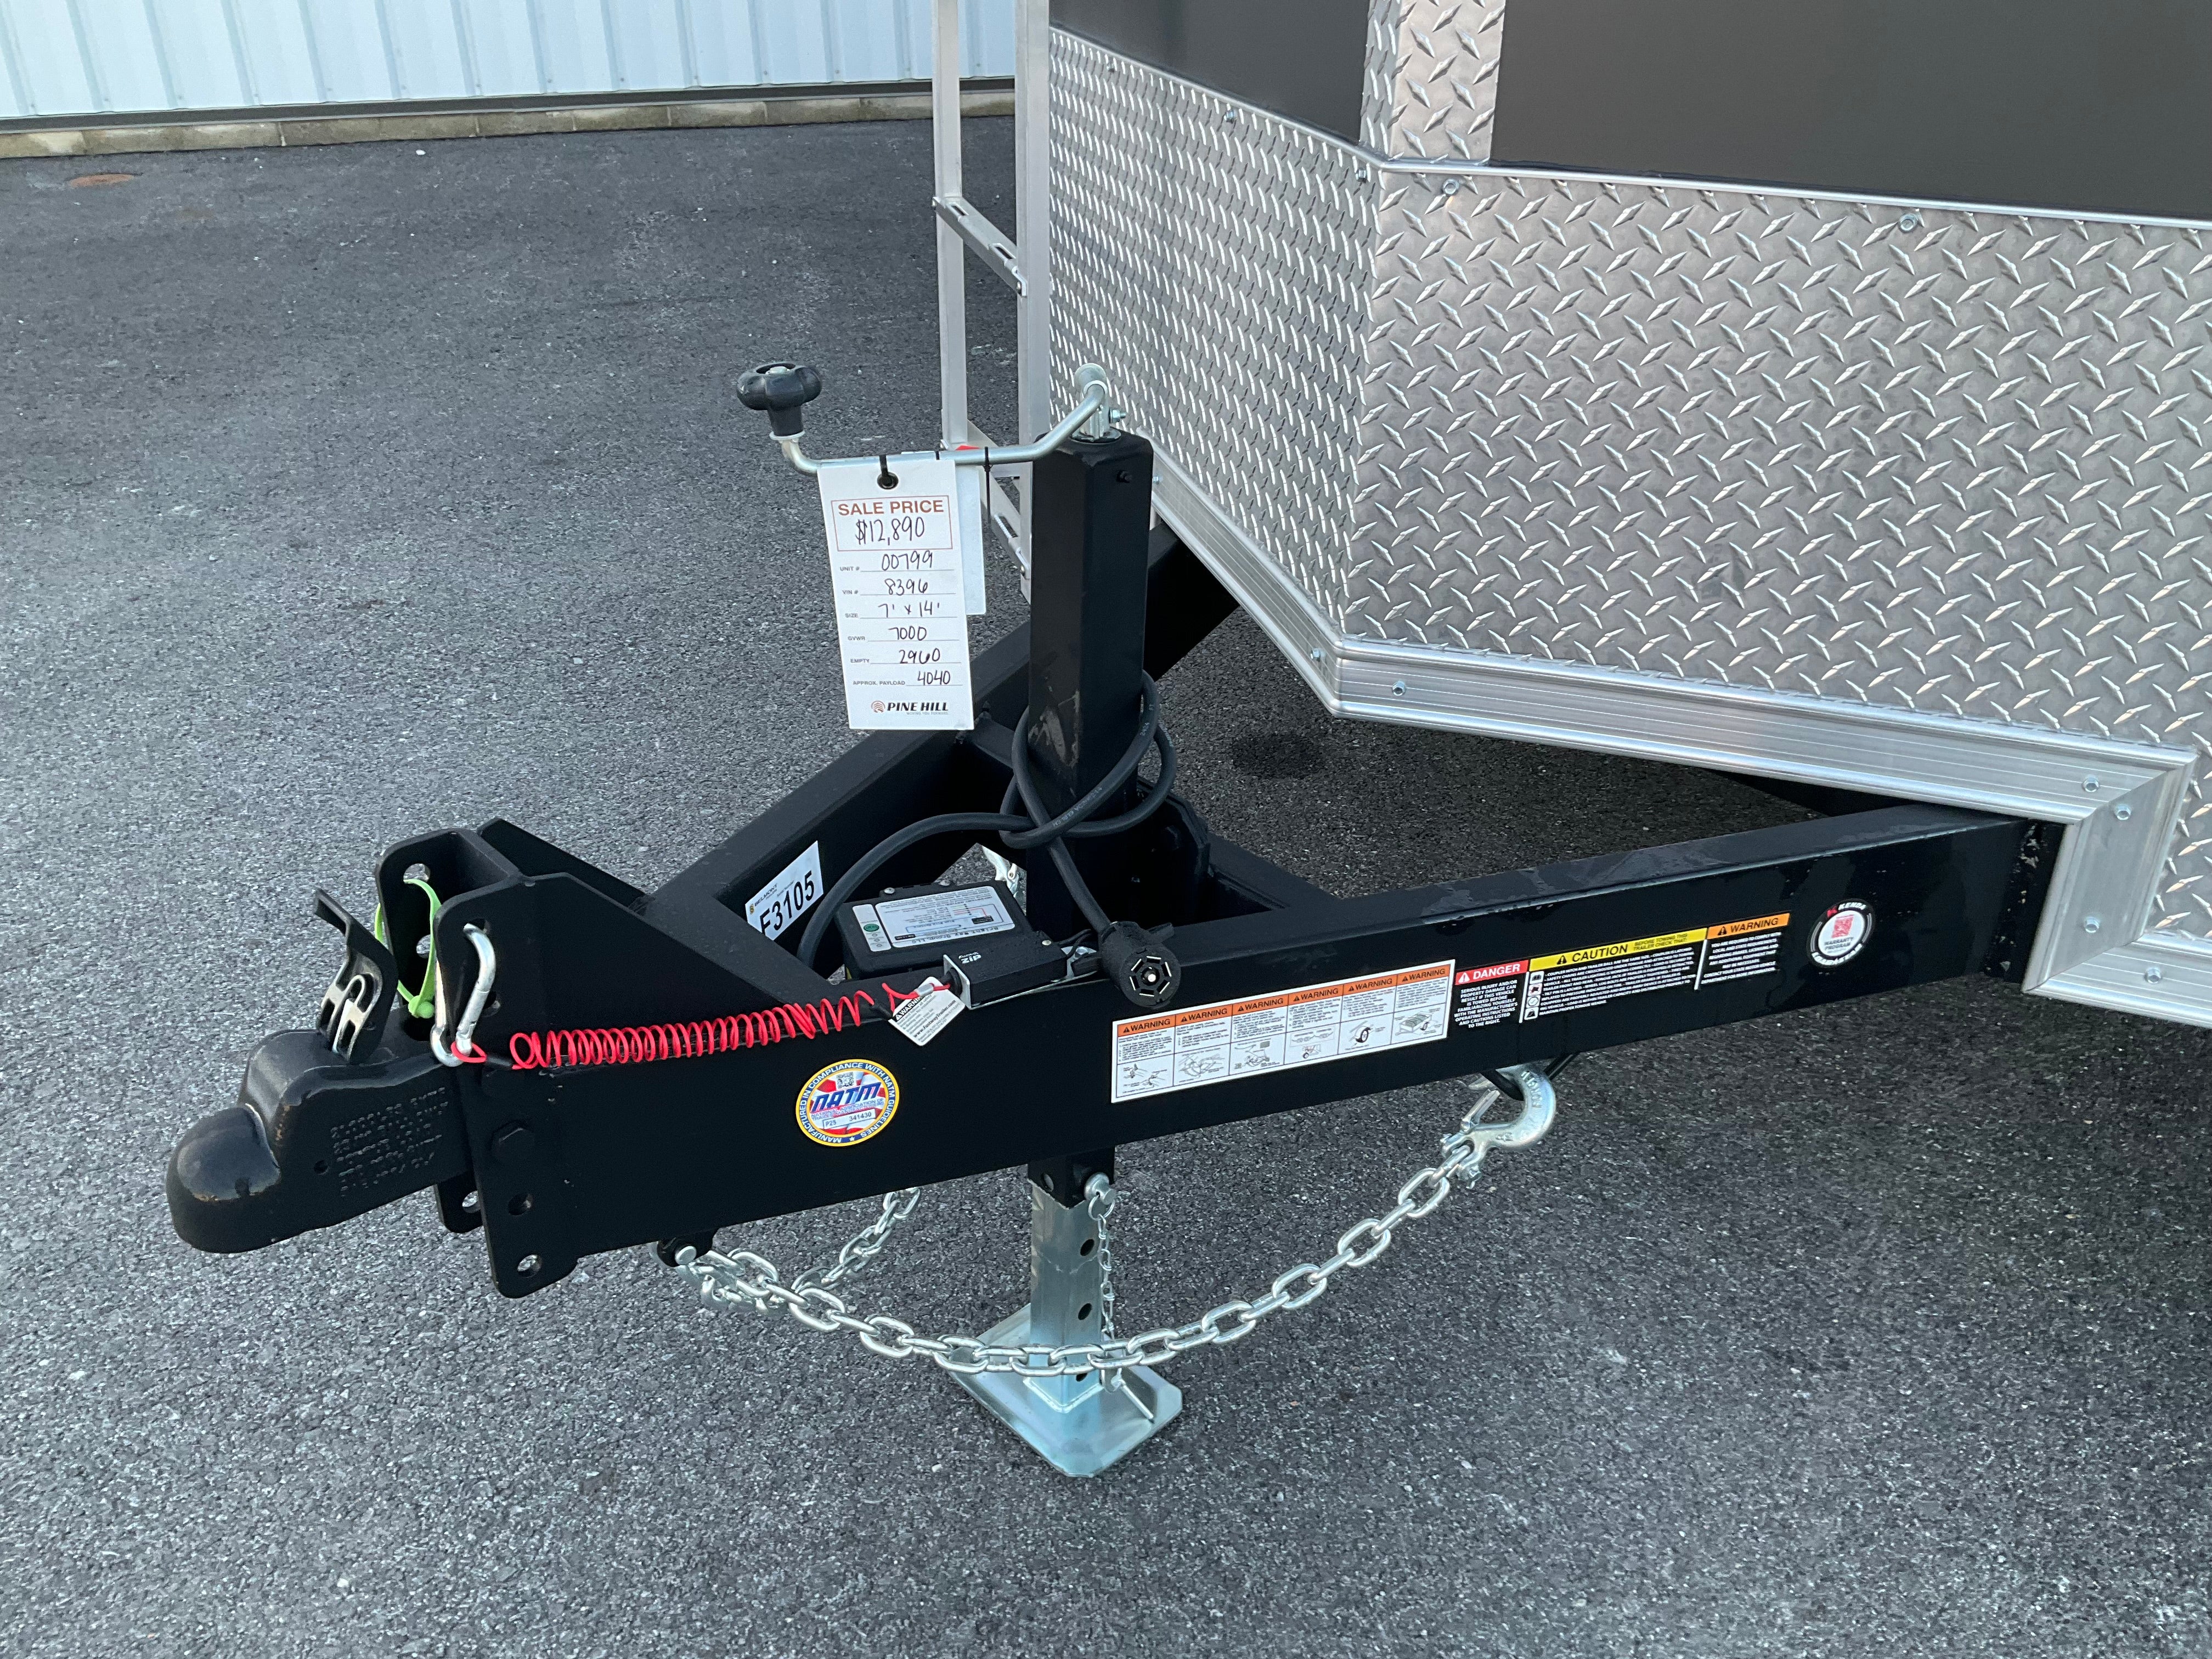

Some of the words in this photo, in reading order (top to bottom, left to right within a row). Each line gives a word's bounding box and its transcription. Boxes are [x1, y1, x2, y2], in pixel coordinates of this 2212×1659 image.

[838, 501, 884, 516] SALE
[890, 500, 944, 514] PRICE
[856, 516, 925, 545] $12,890
[881, 550, 933, 571] 00799
[884, 578, 928, 596] 8396
[888, 625, 927, 641] 7000
[899, 647, 940, 664] 2960
[917, 670, 950, 686] 4040
[888, 702, 918, 711] PINE
[921, 702, 948, 711] HILL
[760, 870, 814, 934] F3105
[1730, 918, 1779, 933] WARNING
[1572, 944, 1628, 962] CAUTION
[1409, 969, 1445, 980] WARNING
[1473, 964, 1520, 980] DANGER
[1355, 979, 1392, 990] WARNING
[1301, 989, 1339, 1000] WARNING
[1245, 998, 1283, 1009] WARNING
[1188, 1008, 1227, 1020] WARNING
[1131, 1019, 1170, 1031] WARNING
[809, 1062, 862, 1090] COMPLIANCE
[865, 1063, 884, 1076] WITH
[803, 1090, 810, 1098] IN
[883, 1076, 895, 1097] NATM
[799, 1100, 842, 1143] MANUFACTURED
[849, 1111, 872, 1121] 341430
[861, 1099, 895, 1137] GUIDELINES
